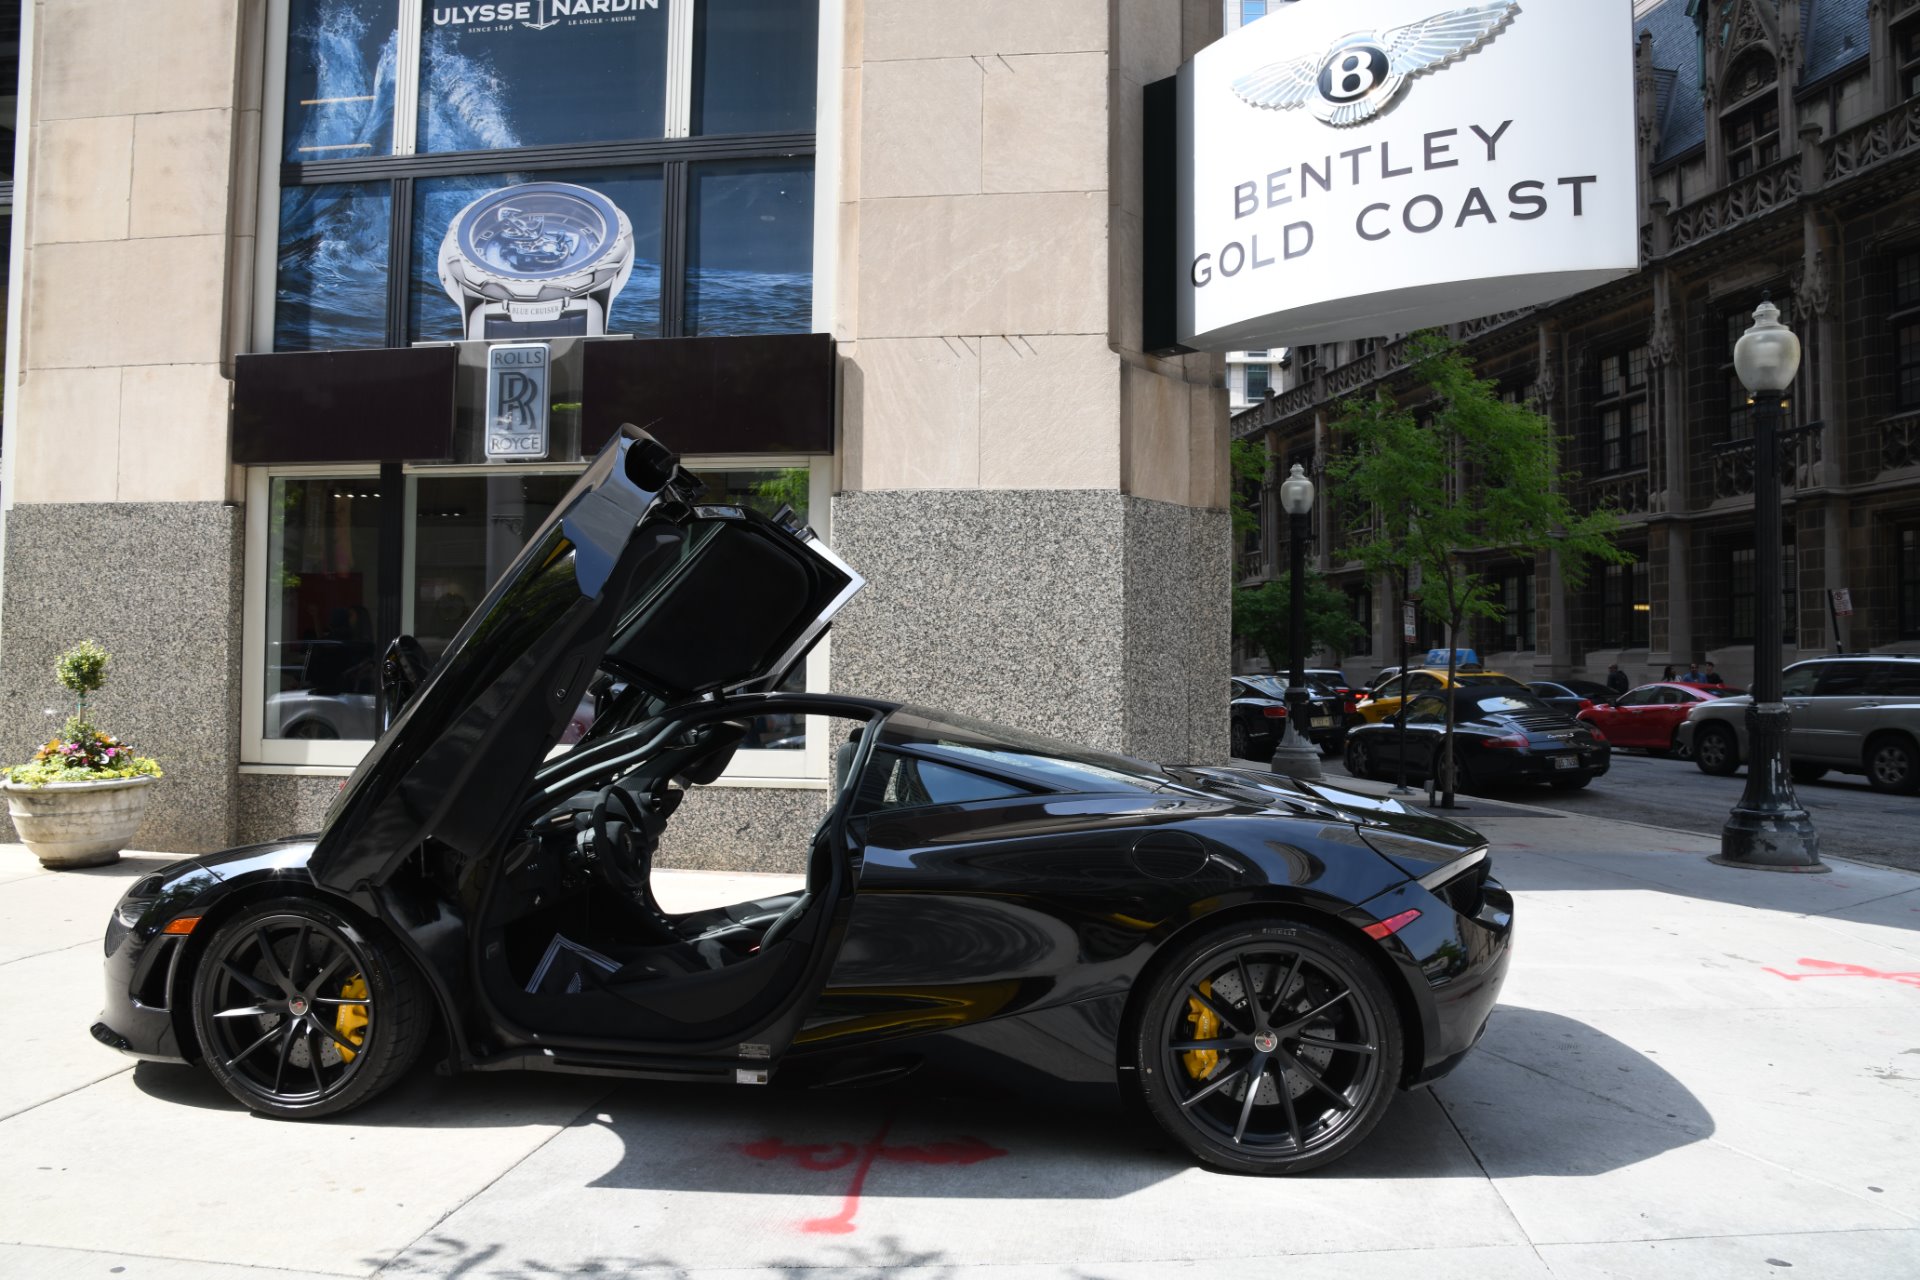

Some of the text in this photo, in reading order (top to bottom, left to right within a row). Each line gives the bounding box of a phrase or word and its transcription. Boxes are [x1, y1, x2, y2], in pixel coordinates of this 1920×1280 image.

[433, 2, 531, 26] ULYSSE
[494, 24, 513, 32] 1846
[1329, 51, 1374, 98] B
[1234, 119, 1514, 220] BENTLEY
[1191, 175, 1598, 289] GOLD COAST
[512, 307, 528, 315] BLUE
[494, 351, 542, 365] ROLLS
[491, 437, 539, 450] ROYCE
